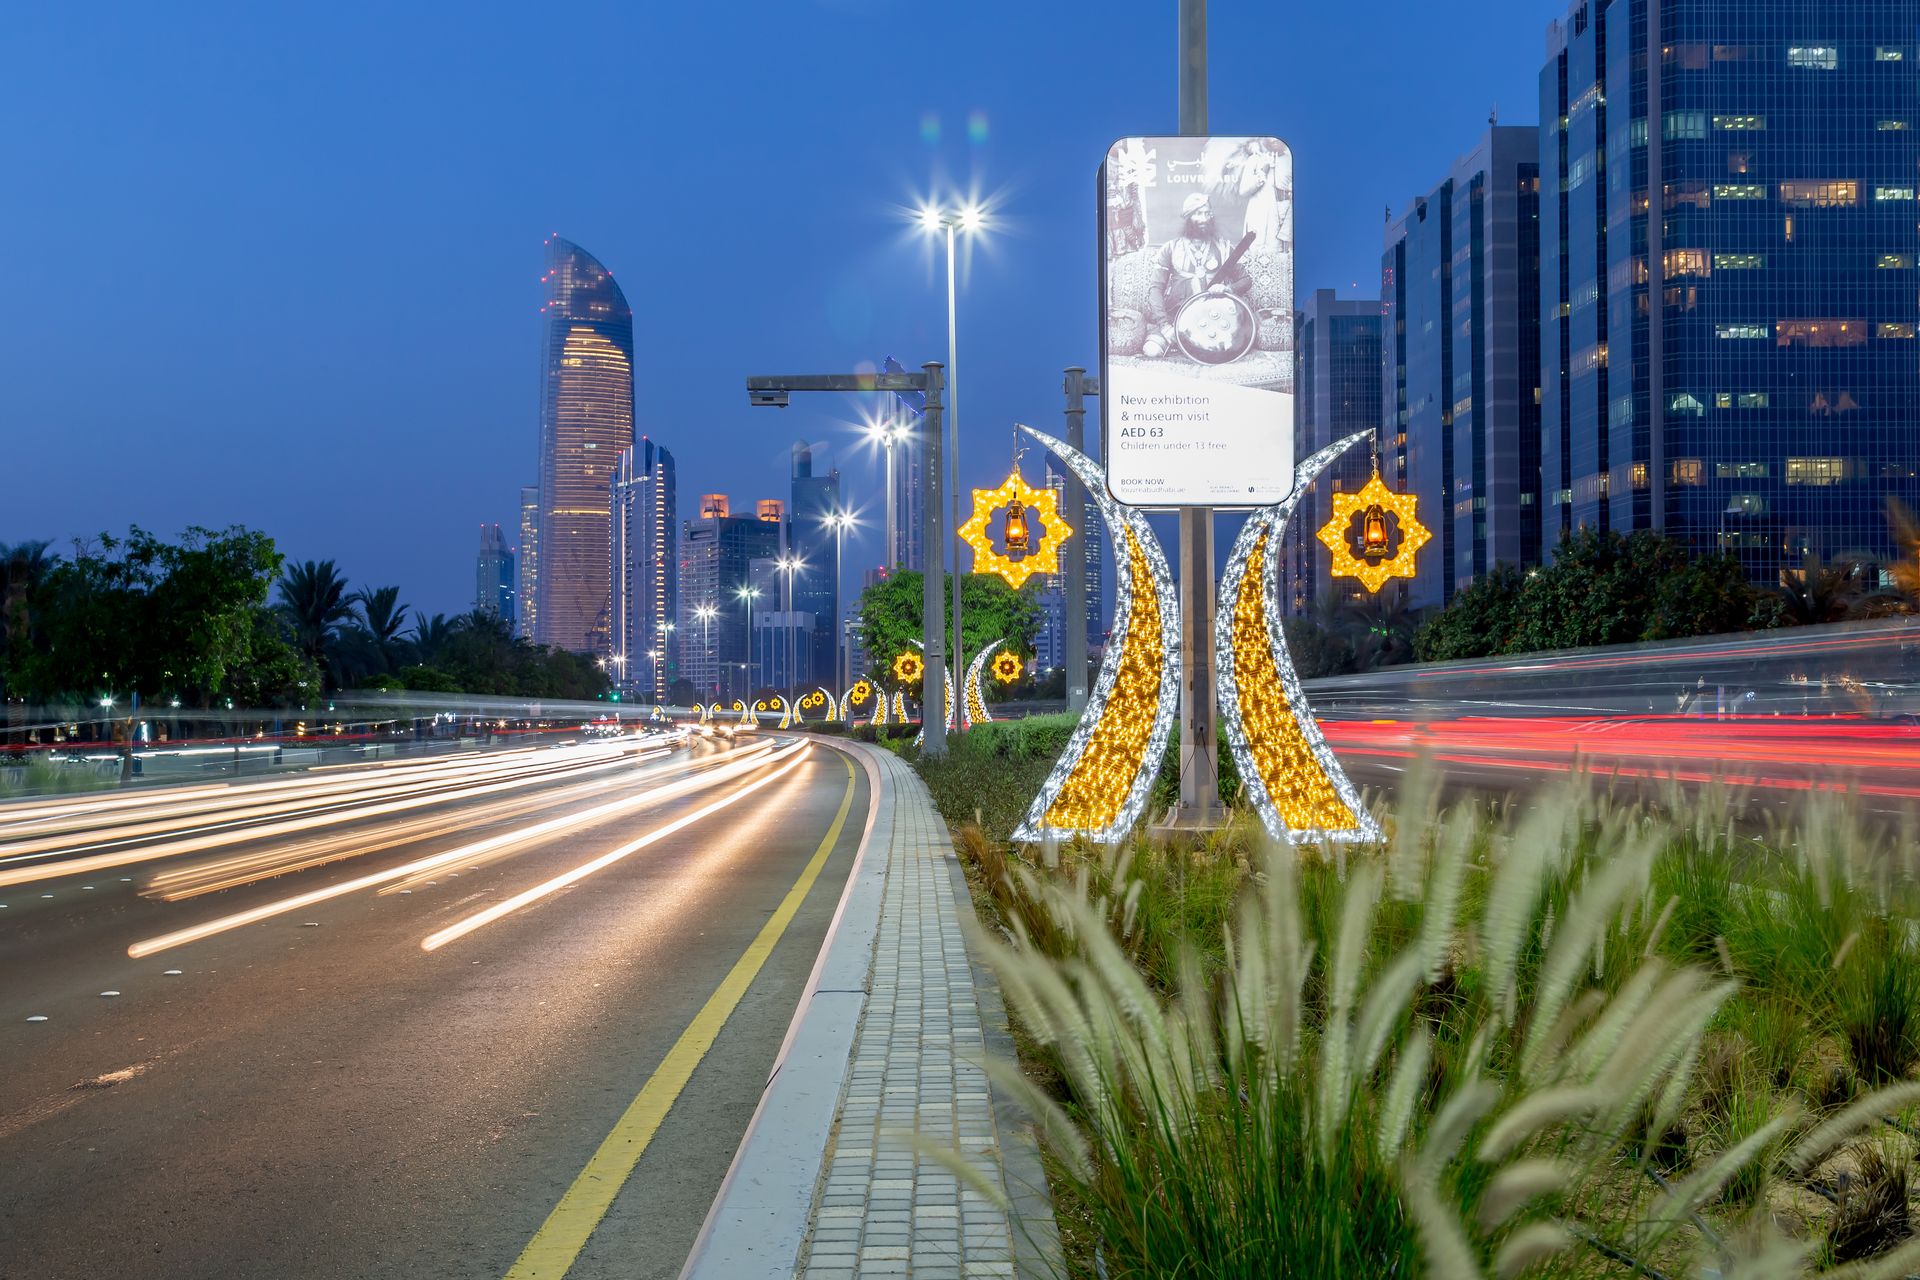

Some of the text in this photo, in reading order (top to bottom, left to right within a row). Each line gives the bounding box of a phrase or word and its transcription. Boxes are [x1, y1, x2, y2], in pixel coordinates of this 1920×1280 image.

[1120, 395, 1210, 406] New exhibition
[1121, 411, 1210, 422] & museum visit
[1120, 427, 1164, 438] AED 63
[1120, 441, 1227, 450] Children under 13 free
[1120, 478, 1165, 486] BOOK NOW
